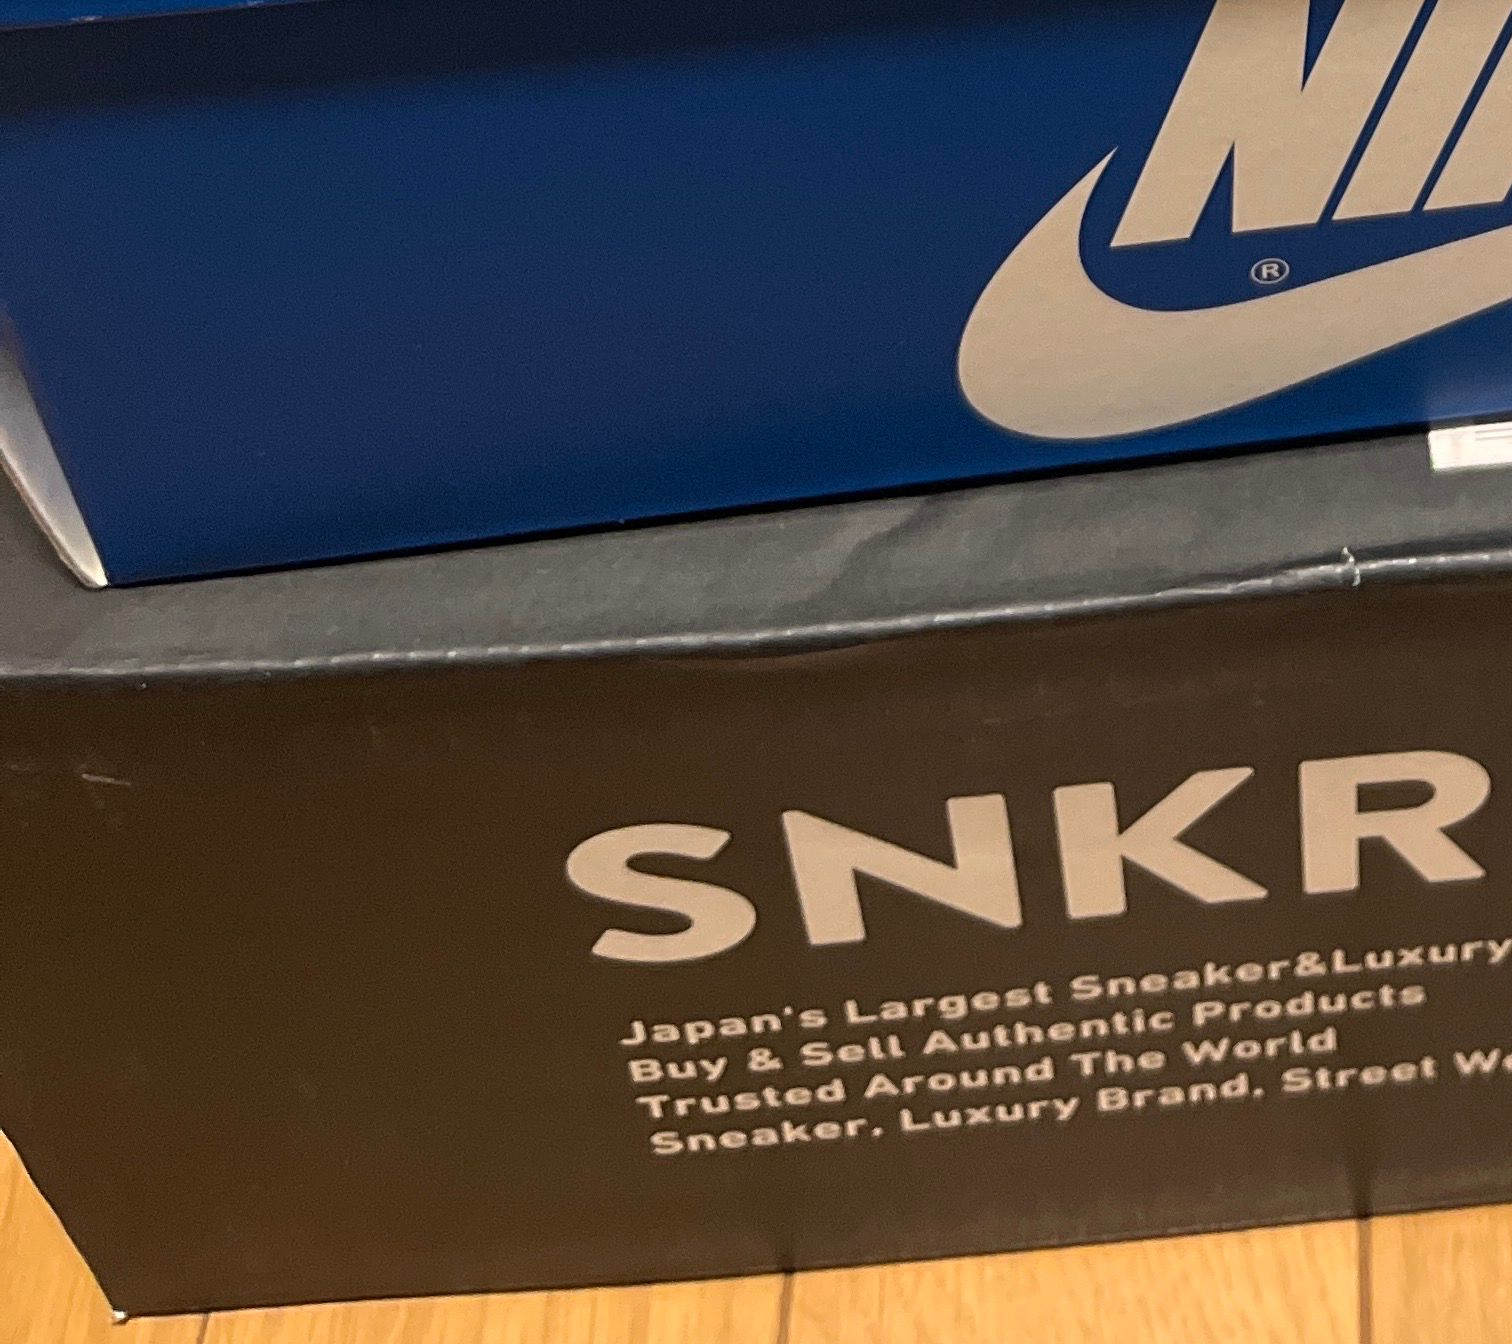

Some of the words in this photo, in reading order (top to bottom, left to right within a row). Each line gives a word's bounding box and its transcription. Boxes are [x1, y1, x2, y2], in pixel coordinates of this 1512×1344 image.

[619, 1006, 828, 1046] Japan's
[843, 981, 1053, 1025] Largest
[627, 1056, 728, 1084] Buy
[747, 1047, 783, 1073] &
[799, 1034, 906, 1067] Sell
[922, 1007, 1175, 1056] Authentic
[1191, 984, 1427, 1029] Products
[635, 1078, 846, 1119] Trusted
[863, 1056, 1055, 1100] Around
[1068, 1049, 1166, 1080] The
[1181, 1026, 1337, 1067] World
[899, 1096, 1080, 1134] Luxury
[1280, 1055, 1436, 1094] Street
